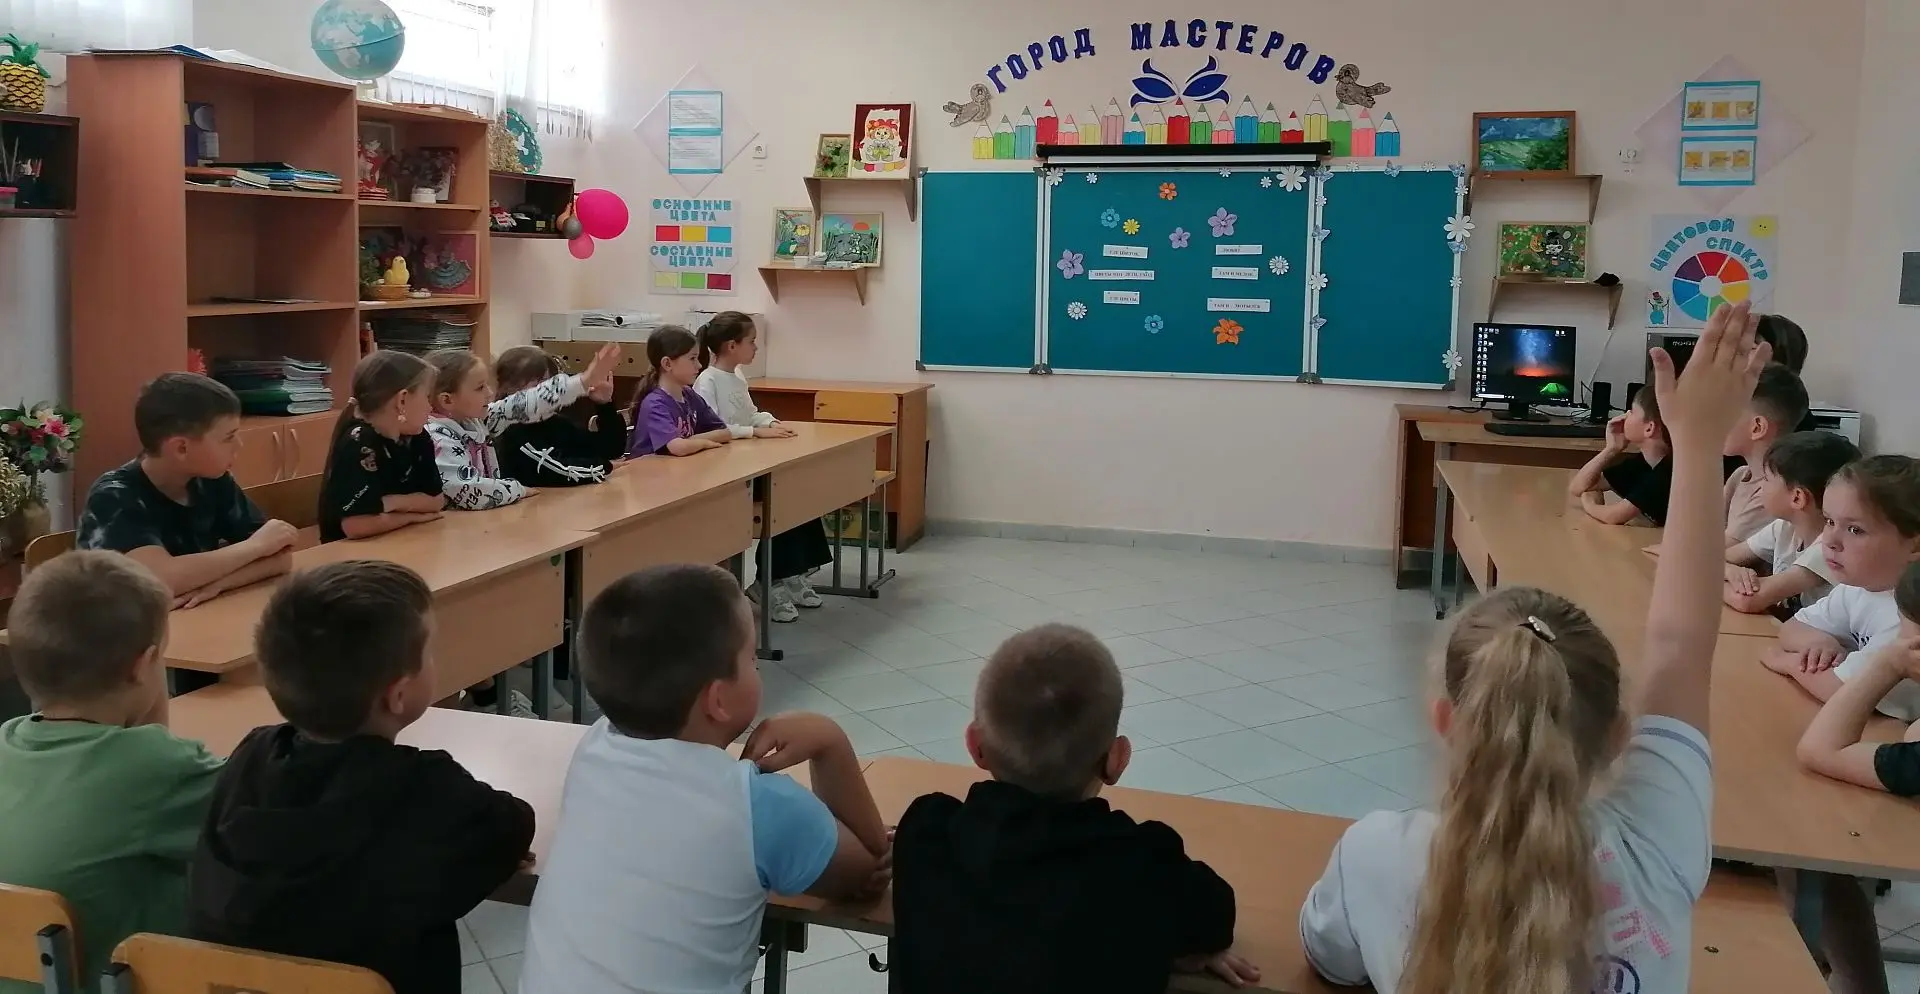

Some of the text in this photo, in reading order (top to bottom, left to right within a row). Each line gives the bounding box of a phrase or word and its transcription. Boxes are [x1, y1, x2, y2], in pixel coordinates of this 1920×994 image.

[986, 18, 1336, 94] ГОРОД МАСТЕРОВ
[652, 199, 732, 211] ОСНОВНЫЕ
[670, 210, 717, 222] ЦВЕТА
[650, 245, 733, 257] СОСТАВНЫЕ
[1650, 218, 1735, 272] ЦВЕТОВОЙ
[669, 256, 714, 267] ЦВЕТА
[1706, 236, 1769, 280] СПЕКТР
